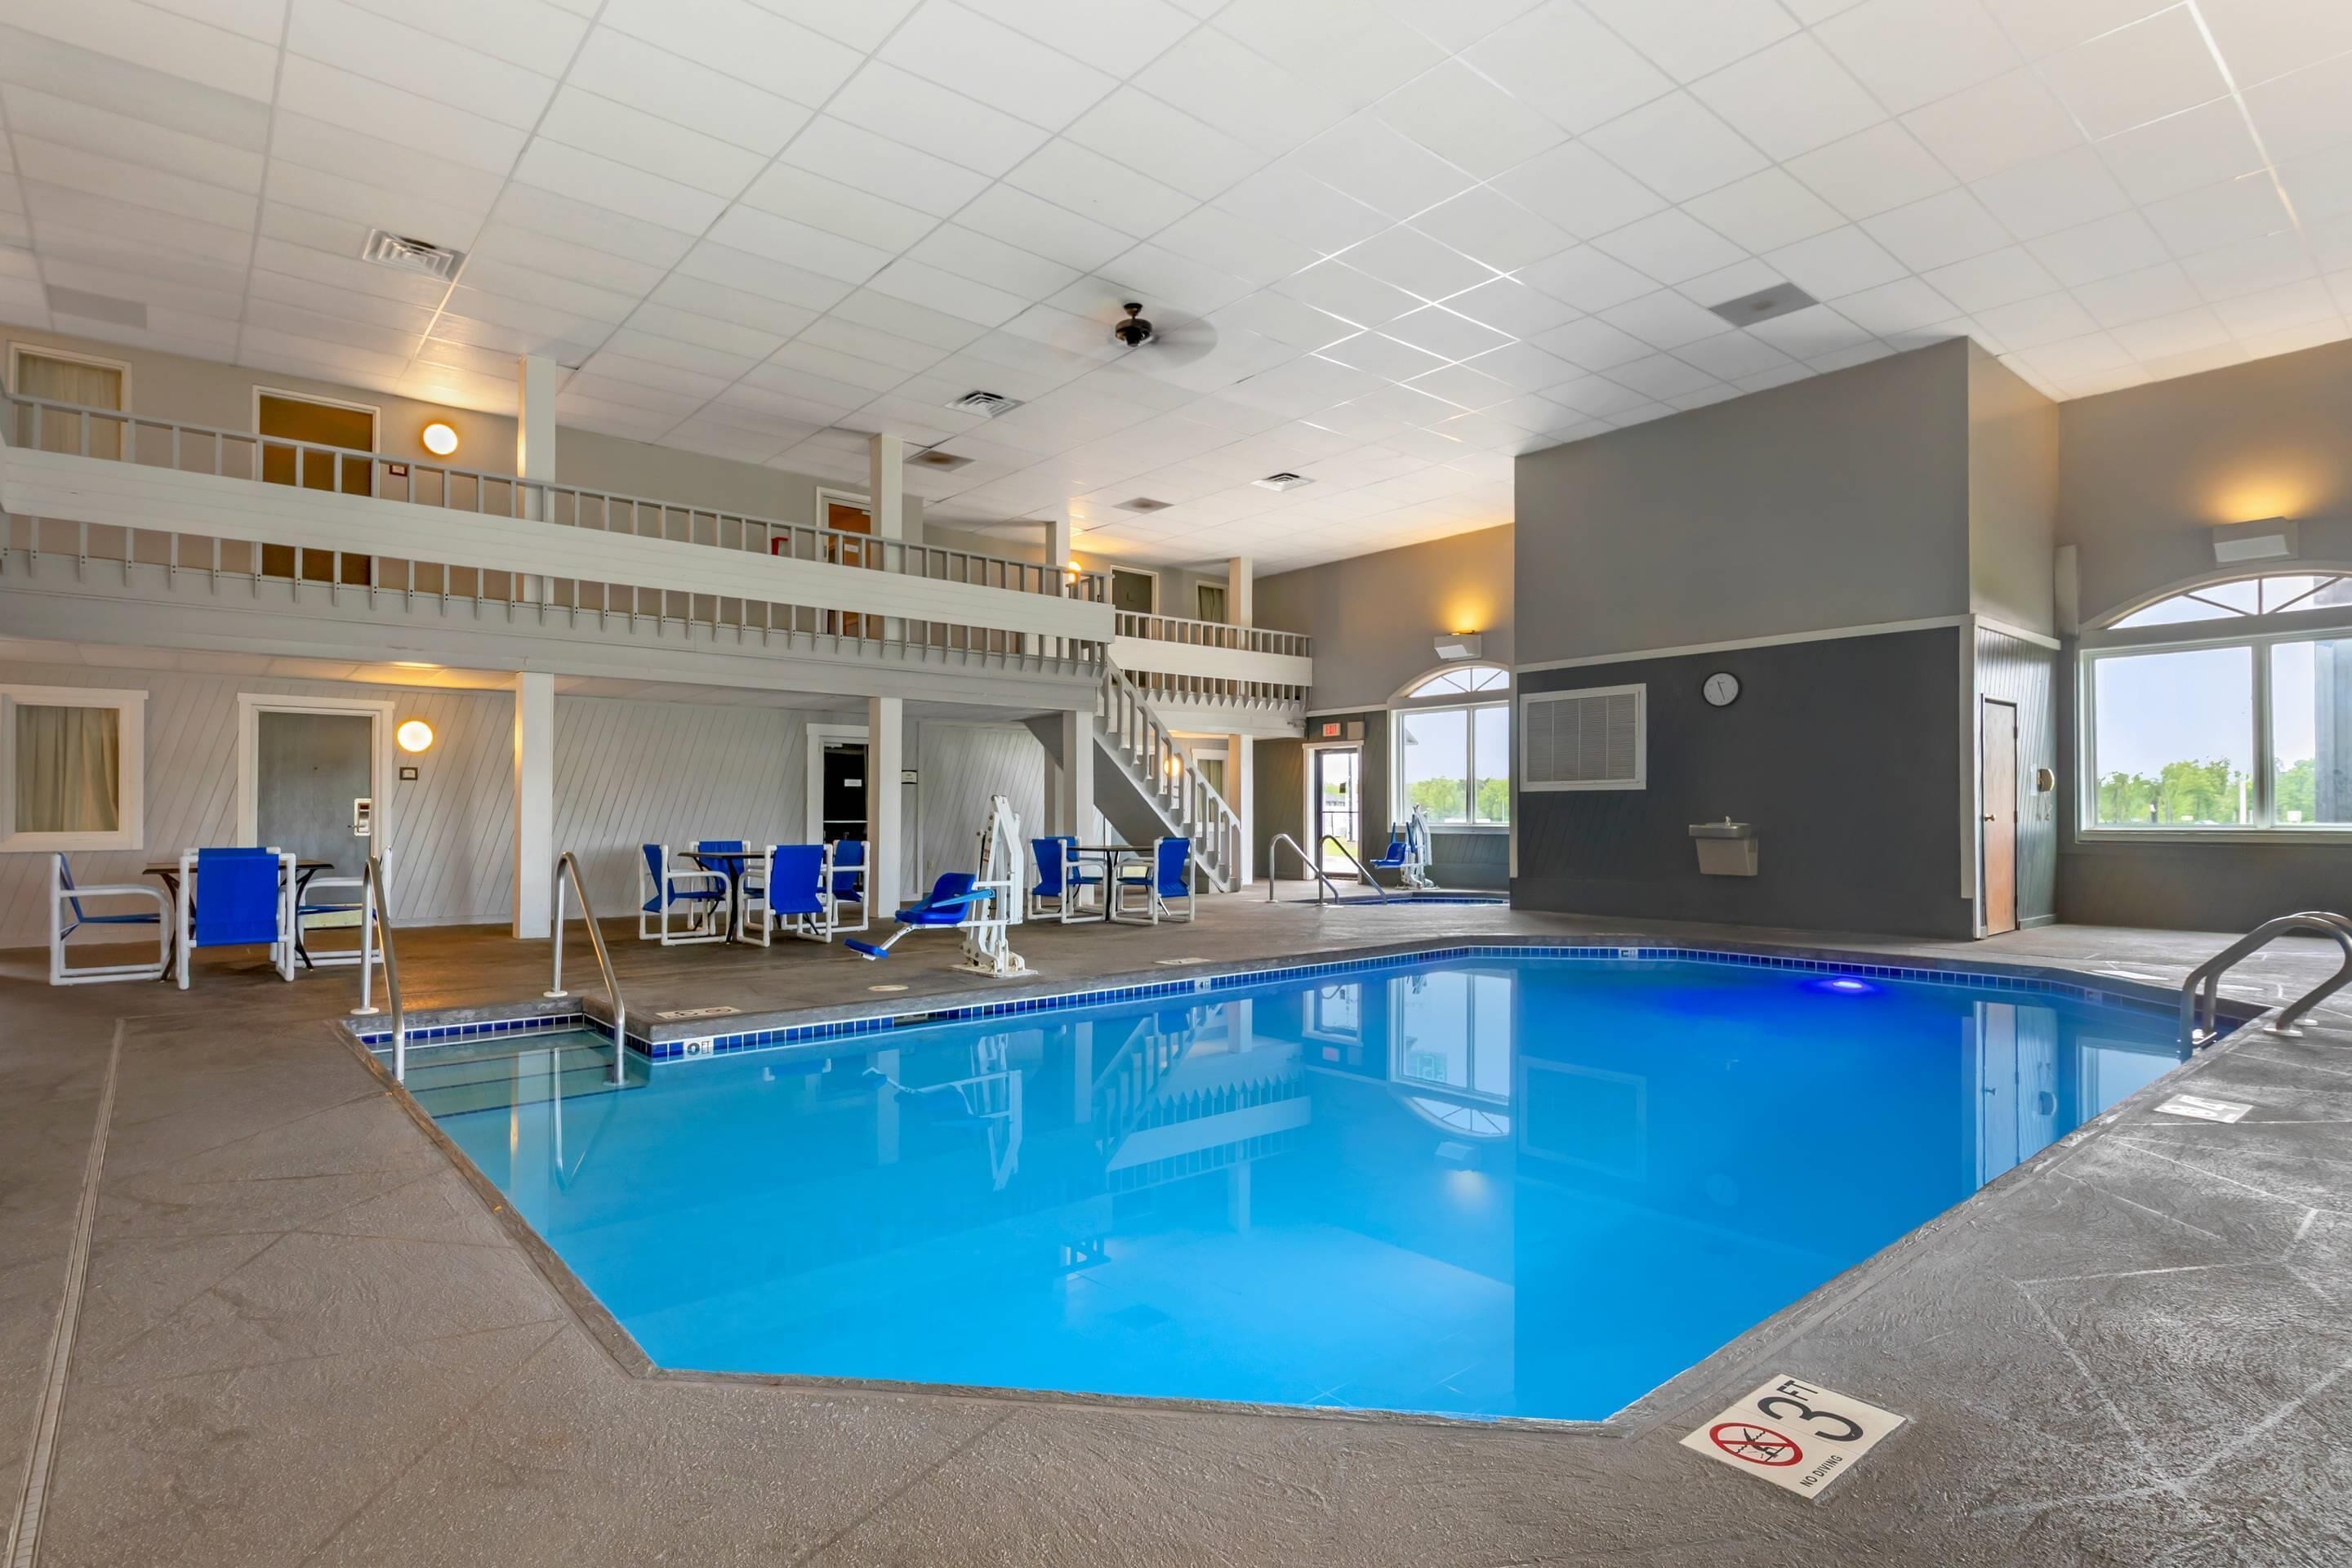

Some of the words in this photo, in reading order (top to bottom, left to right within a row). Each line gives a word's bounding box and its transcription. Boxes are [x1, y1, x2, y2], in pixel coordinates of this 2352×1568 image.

[1776, 1379, 1820, 1401] FT
[1757, 1396, 1864, 1442] 3
[1799, 1475, 1819, 1488] NO
[1812, 1454, 1843, 1477] DIVING
